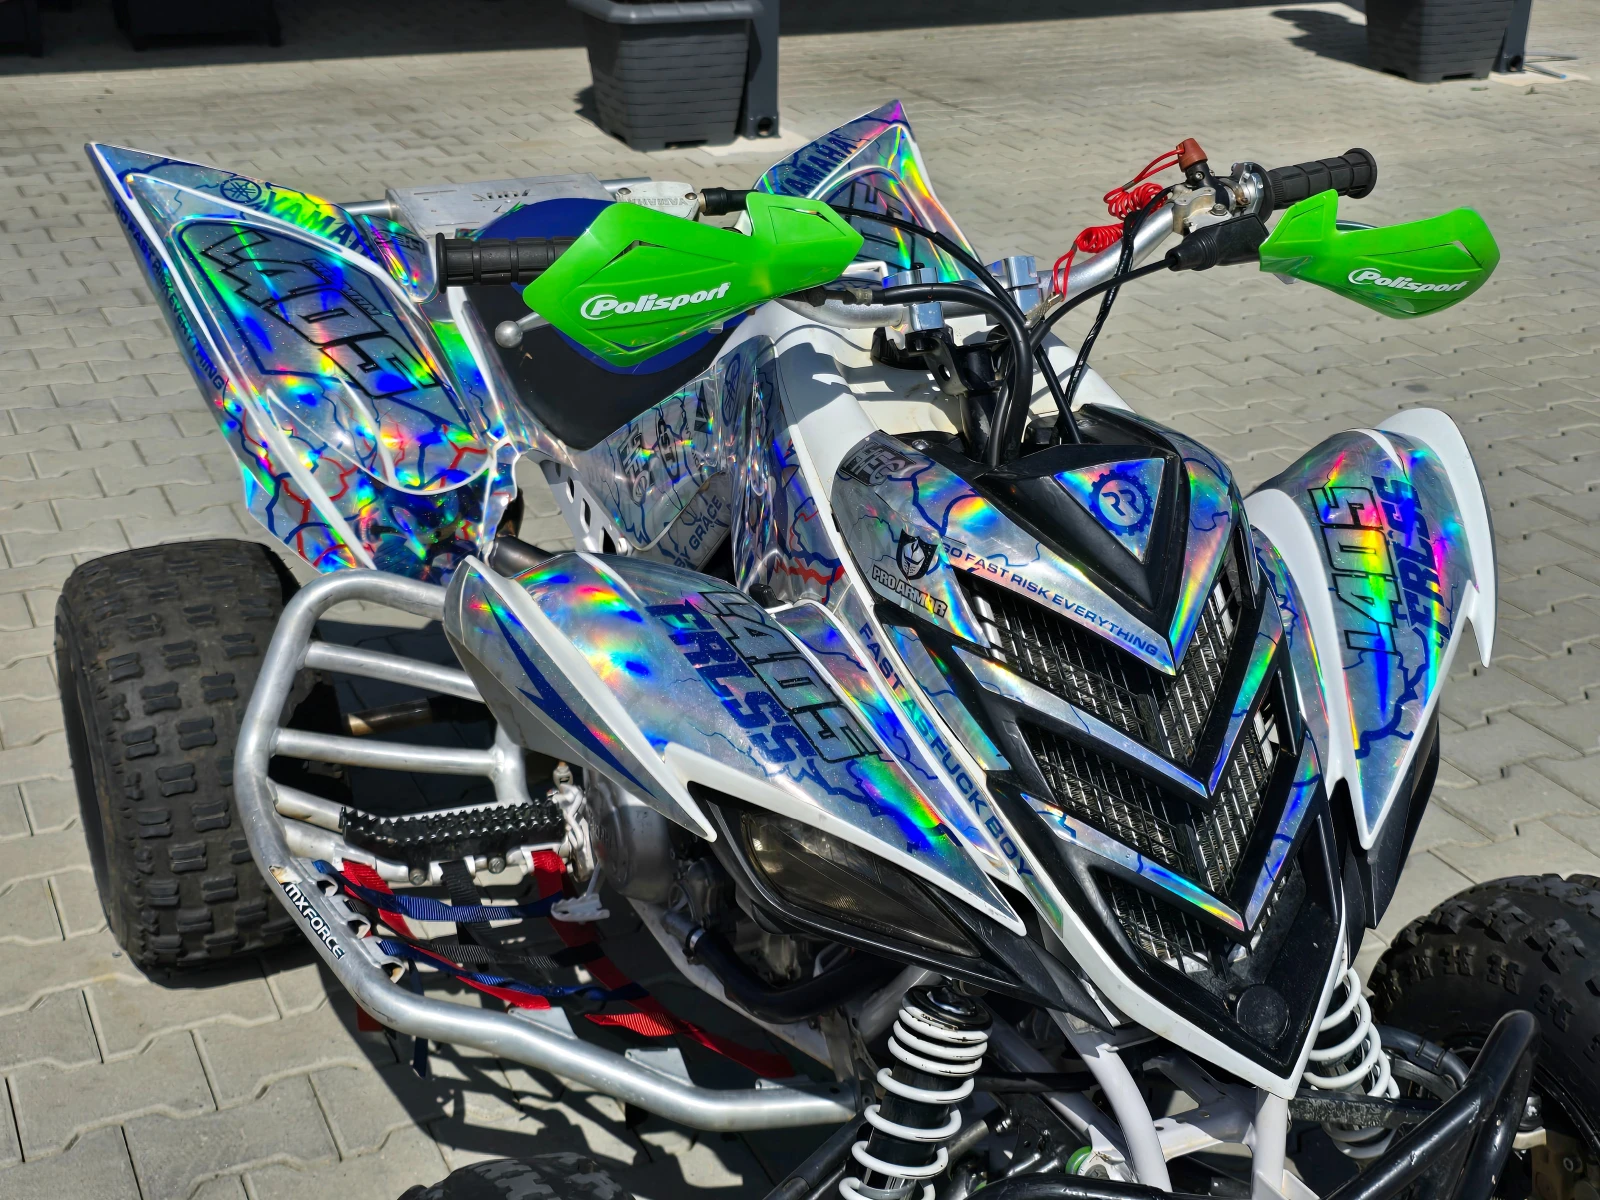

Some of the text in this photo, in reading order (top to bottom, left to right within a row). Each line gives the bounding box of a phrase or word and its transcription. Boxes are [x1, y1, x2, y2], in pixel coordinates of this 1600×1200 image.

[580, 281, 731, 320] Polisport
[1348, 267, 1469, 294] Polisport
[690, 495, 723, 550] GRACE
[871, 564, 949, 617] PRO ARMOR
[965, 552, 1010, 580] FAST
[1010, 573, 1050, 601] RISK
[1051, 595, 1159, 657] EVERYTHING
[859, 621, 1033, 877] FAST AS FUCK BOY
